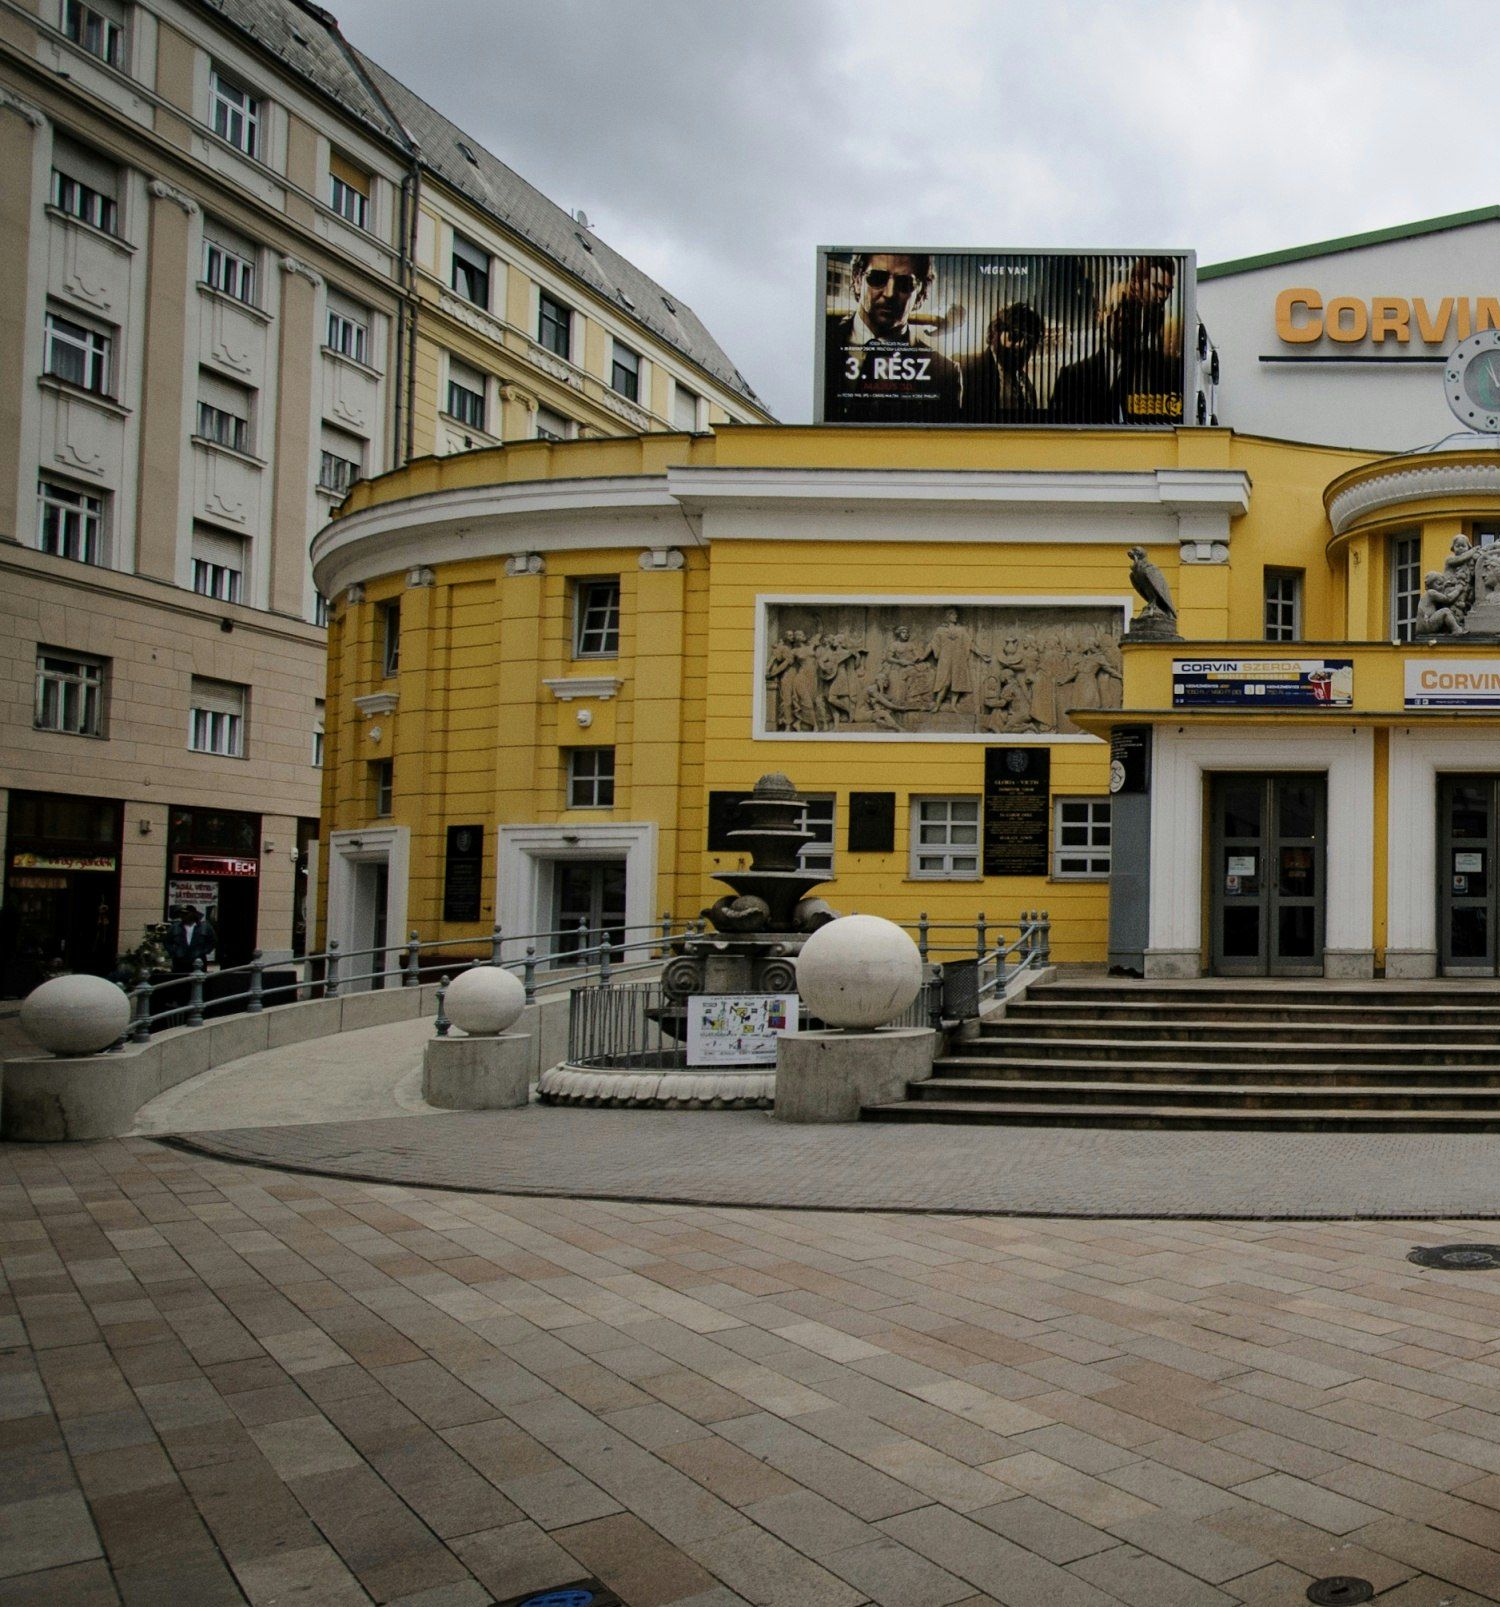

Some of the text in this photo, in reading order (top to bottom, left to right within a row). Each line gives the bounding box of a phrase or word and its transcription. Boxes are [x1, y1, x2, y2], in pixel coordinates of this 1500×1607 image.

[1007, 265, 1028, 275] VAN
[845, 351, 932, 380] 3. RÉSZ
[1181, 663, 1301, 672] CORVIN SZERDA
[221, 858, 257, 873] TECH
